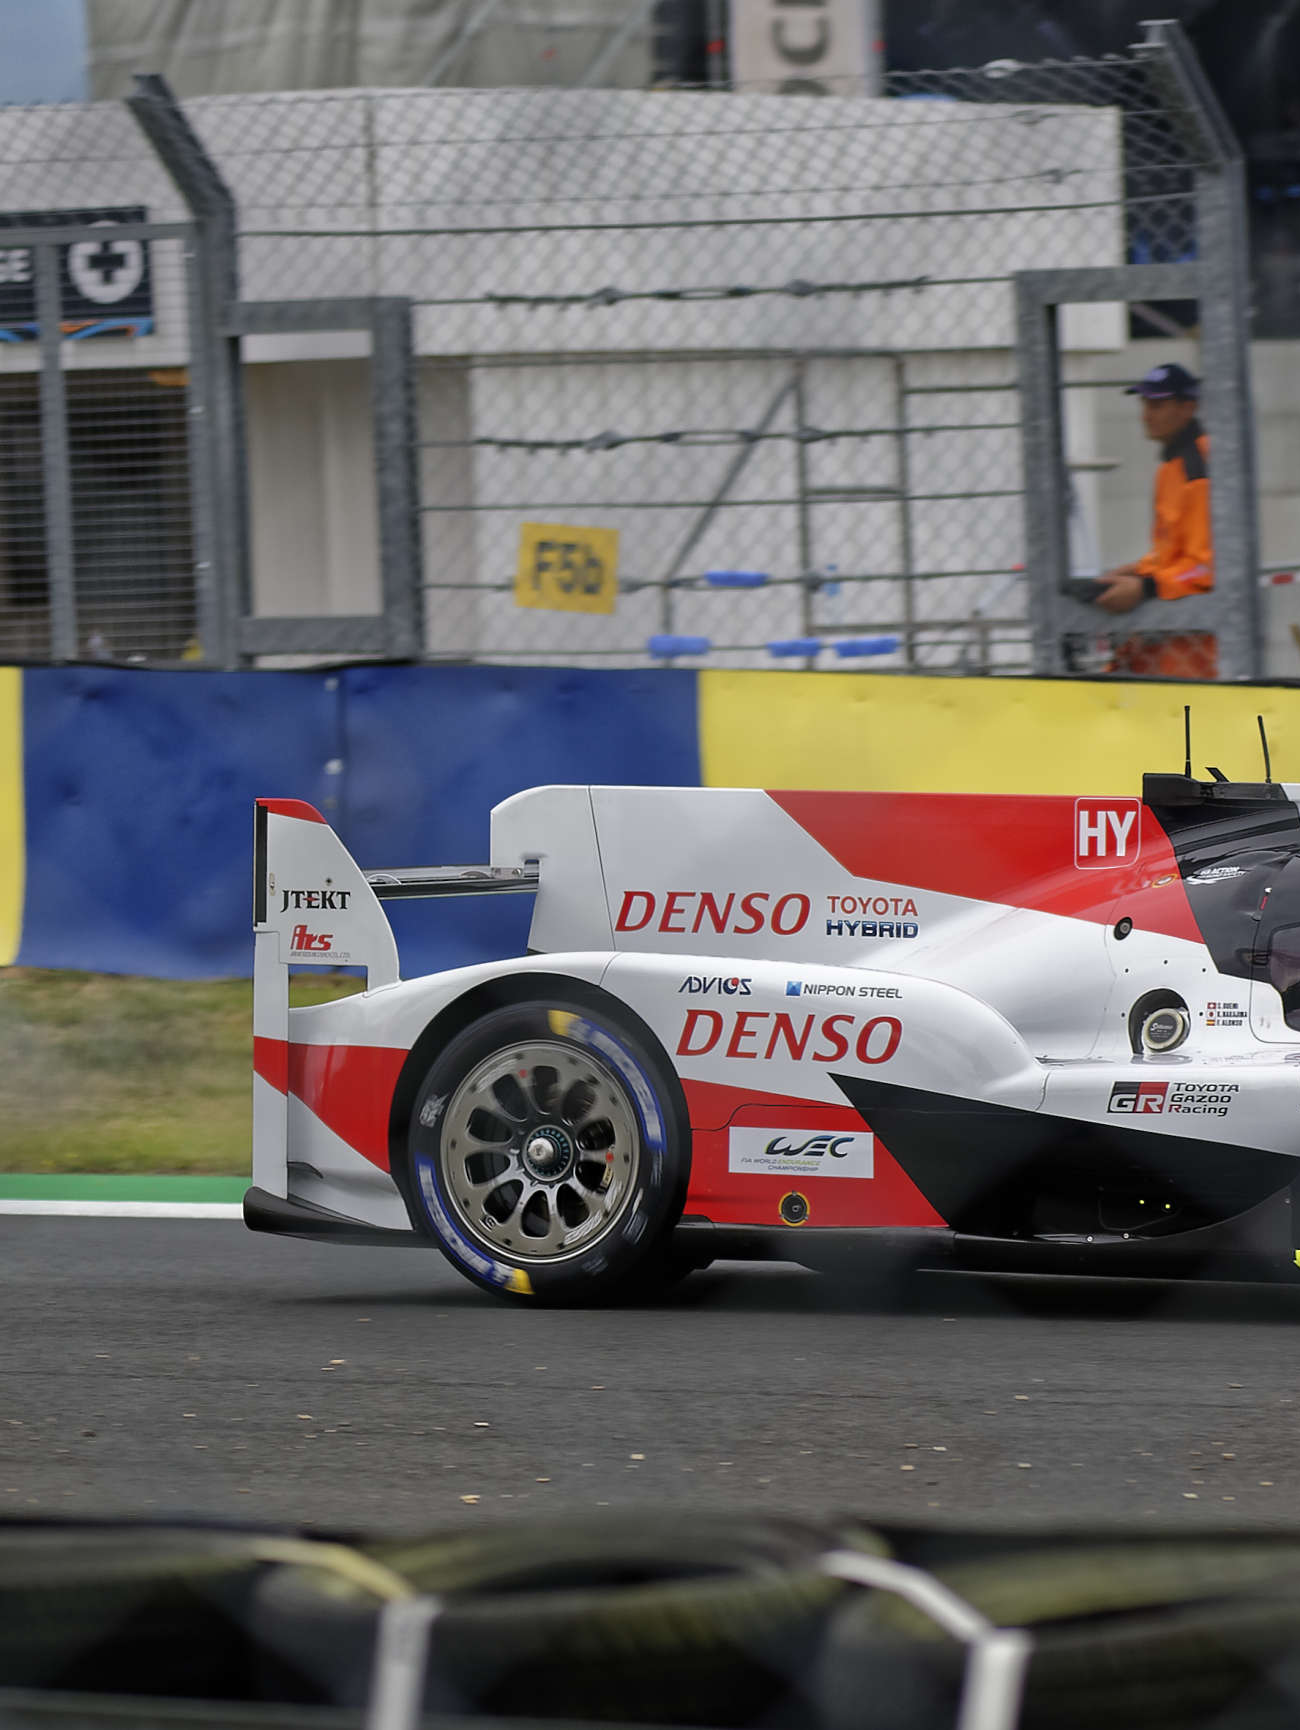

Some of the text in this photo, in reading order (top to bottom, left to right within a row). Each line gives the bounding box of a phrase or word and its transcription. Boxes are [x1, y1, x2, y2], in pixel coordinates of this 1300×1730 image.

[1078, 810, 1137, 857] HY
[280, 889, 351, 913] JTEKT
[827, 895, 919, 916] TOYOTA
[614, 890, 811, 936] DENSO
[826, 919, 919, 939] HYBRID
[803, 983, 904, 999] NIPPON STEEL
[675, 1009, 904, 1065] DENSO
[1173, 1082, 1239, 1093] TOYOTA
[1110, 1093, 1164, 1112] GR
[1171, 1093, 1232, 1104] GAZOO
[1168, 1104, 1229, 1117] Racing
[764, 1134, 856, 1159] WEC
